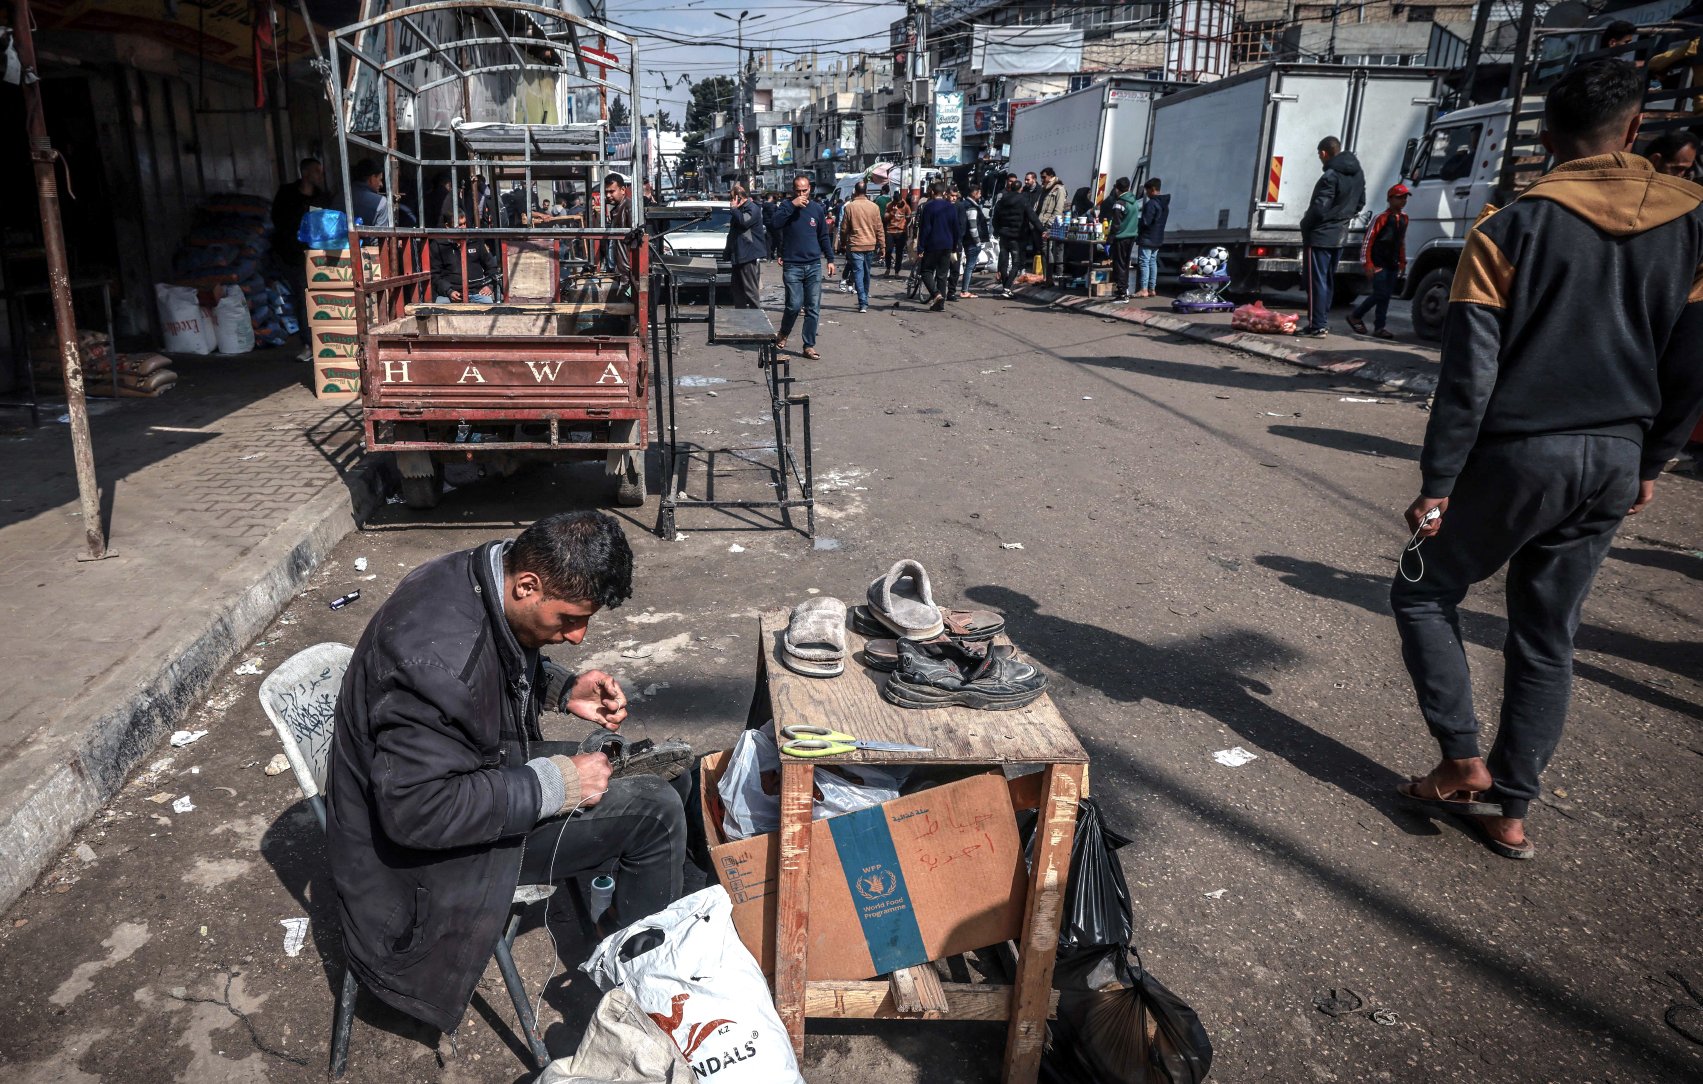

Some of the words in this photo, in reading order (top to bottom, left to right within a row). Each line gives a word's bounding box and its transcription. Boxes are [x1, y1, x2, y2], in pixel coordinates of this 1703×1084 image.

[863, 864, 882, 873] WFP
[863, 902, 885, 912] World
[885, 896, 904, 906] Food
[864, 904, 907, 919] Programme
[691, 1040, 757, 1080] NDALS
